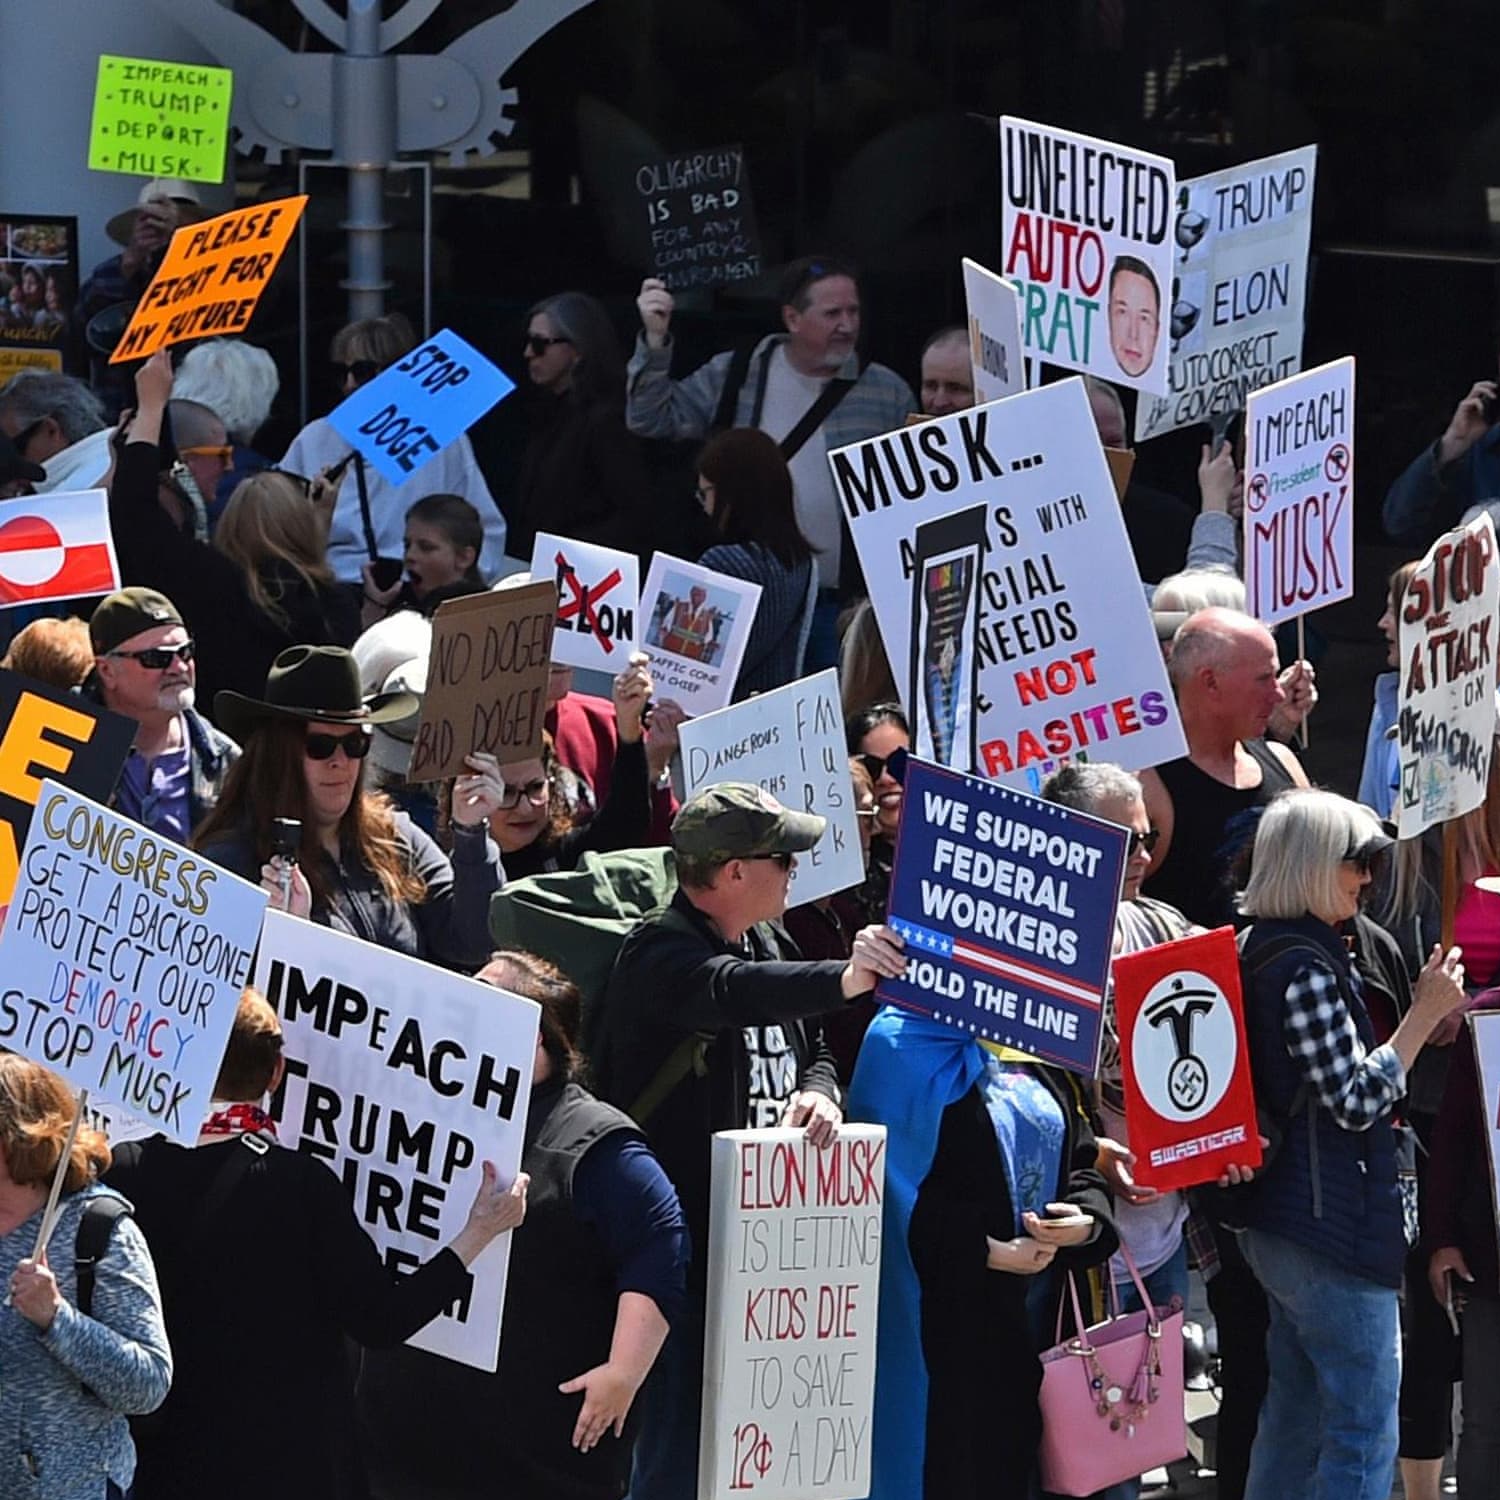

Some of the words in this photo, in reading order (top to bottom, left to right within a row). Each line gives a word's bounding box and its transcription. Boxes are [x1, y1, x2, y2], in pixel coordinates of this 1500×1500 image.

[120, 89, 207, 114] TRUMP
[123, 64, 208, 86] IMPEACH
[116, 120, 204, 146] DEPORT
[648, 199, 670, 224] IS
[690, 189, 739, 214] BAD
[1005, 127, 1168, 245] UNELECTED
[1214, 166, 1306, 233] TRUMP
[184, 208, 282, 259] PLEASE
[1006, 213, 1104, 297] AUTO
[141, 265, 217, 313] FIGHT
[220, 253, 273, 288] FOR
[1212, 263, 1289, 327] ELON
[117, 325, 152, 358] MY
[158, 299, 257, 345] FUTURE
[1168, 331, 1279, 392] UTOCORRECT
[397, 344, 469, 395] STOP
[358, 404, 441, 473] DOGE
[1254, 389, 1345, 468] IMPEACH
[1037, 493, 1087, 534] WITH
[980, 554, 1065, 618] CIAL
[1253, 486, 1348, 619] MUSK
[1404, 525, 1493, 625] STOP
[431, 632, 471, 686] NO
[978, 601, 1078, 670] NEEDS
[1406, 615, 1491, 699] ATTACK
[1014, 648, 1097, 706] NOT
[414, 719, 454, 774] BAD
[980, 691, 1168, 778] RASITES
[43, 795, 217, 914] CONGRESS
[924, 792, 968, 834] WE
[976, 810, 1102, 879] SUPPORT
[933, 838, 1077, 918] FEDERAL
[26, 845, 100, 909] GET
[103, 881, 123, 928] A
[128, 900, 252, 989] BACKBONE
[921, 880, 1079, 966] WORKERS
[17, 889, 156, 991] PROTECT
[158, 968, 216, 1030] OUR
[49, 961, 195, 1071] DEMOCRACY
[901, 959, 964, 999] HOLD
[973, 981, 1016, 1018] THE
[1024, 1002, 1079, 1041] LINE
[0, 990, 94, 1068] STOP
[99, 1041, 192, 1134] MUSK
[266, 960, 521, 1120] IMPEACH
[270, 1060, 475, 1185] TRUMP
[1150, 1125, 1247, 1167] SWASTICAR
[740, 1140, 807, 1209] ELON
[815, 1139, 884, 1208] MUSK
[739, 1220, 769, 1273] IS
[779, 1215, 879, 1271] LETTING
[744, 1287, 807, 1342] KIDS
[817, 1285, 860, 1338] DIE
[747, 1357, 782, 1409] TO
[792, 1352, 859, 1409] SAVE
[729, 1423, 772, 1490] 12¢
[783, 1421, 801, 1486] A
[813, 1416, 868, 1485] DAY
